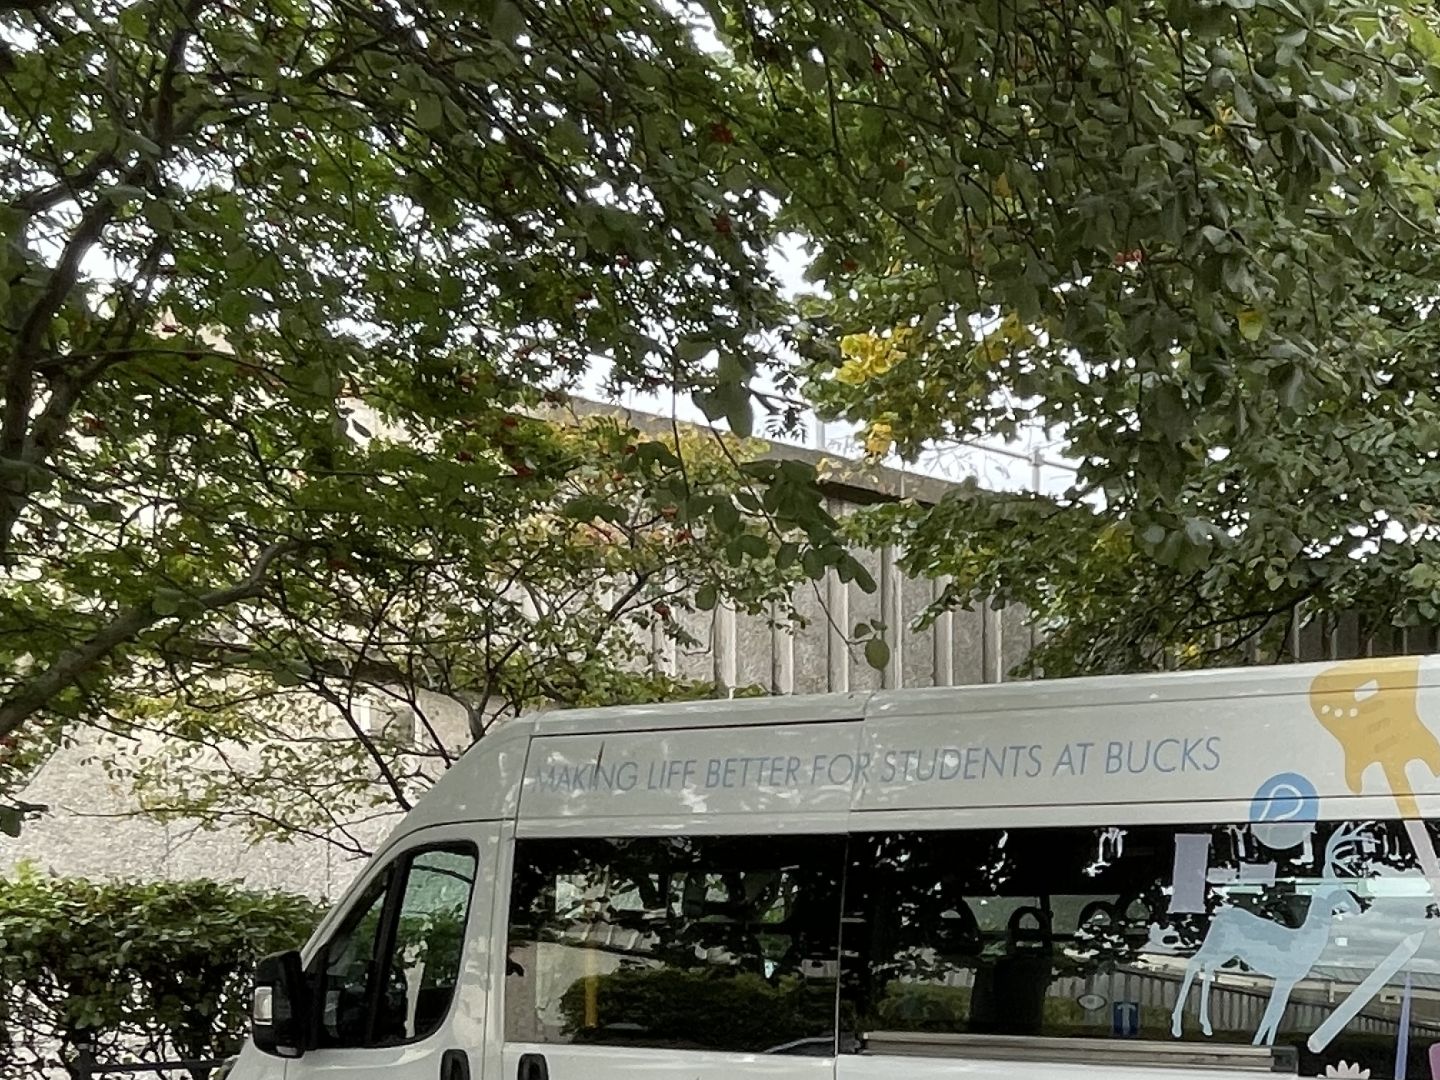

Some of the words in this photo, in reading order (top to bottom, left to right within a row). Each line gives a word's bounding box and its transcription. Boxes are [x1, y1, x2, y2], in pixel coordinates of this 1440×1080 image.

[531, 760, 639, 793] MAKING
[647, 759, 698, 791] LIFE
[704, 756, 800, 789] BETTER
[810, 752, 871, 785] FOR
[879, 744, 1042, 783] STUDENTS
[1051, 742, 1095, 776] AT
[1104, 736, 1221, 775] BUCKS
